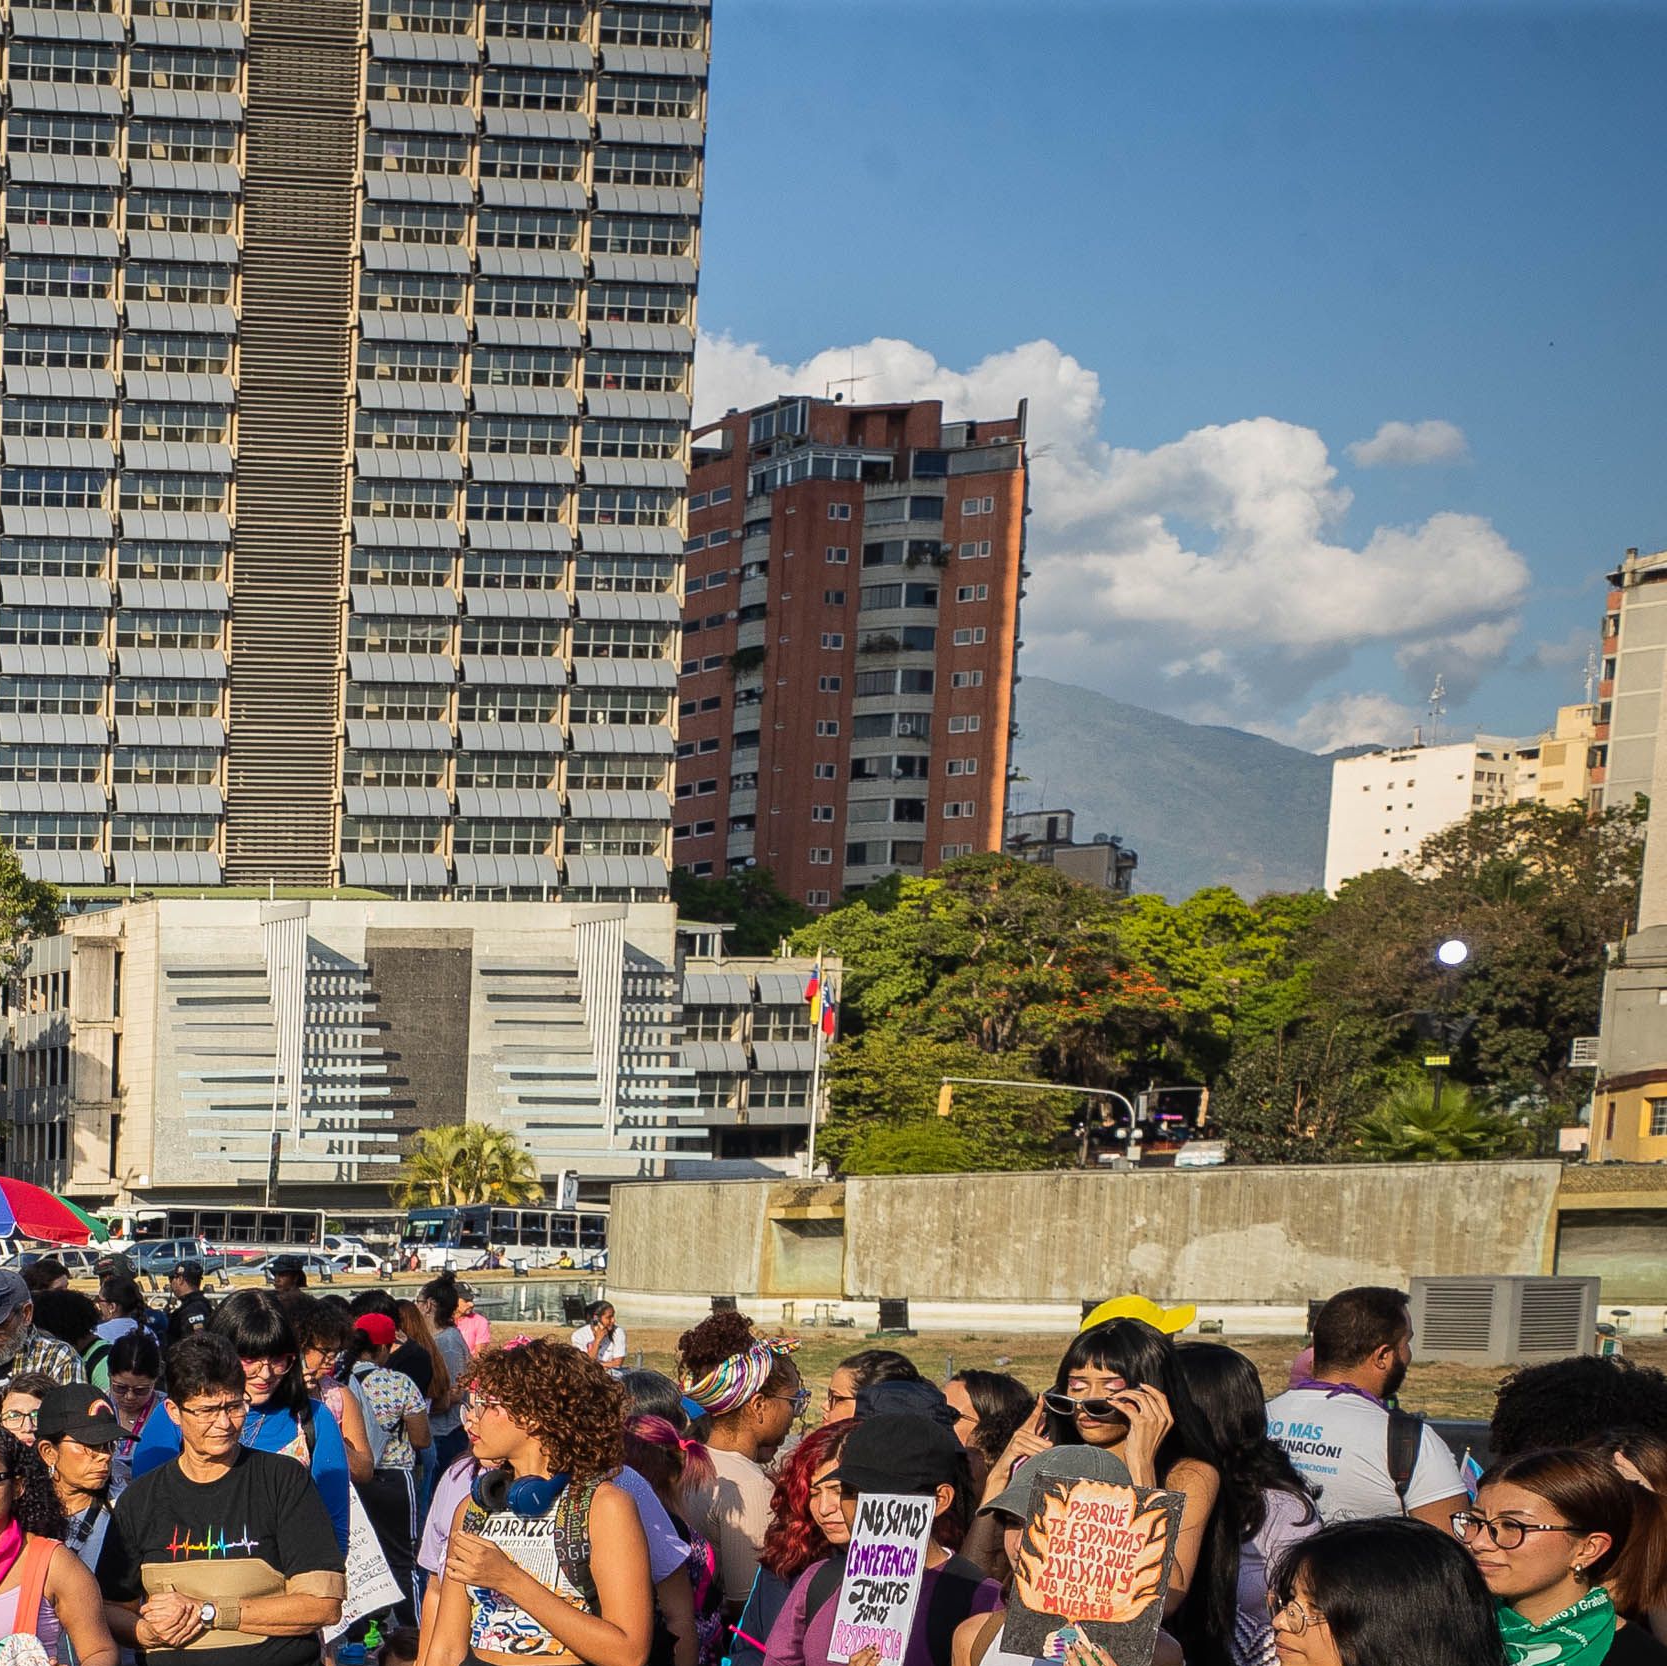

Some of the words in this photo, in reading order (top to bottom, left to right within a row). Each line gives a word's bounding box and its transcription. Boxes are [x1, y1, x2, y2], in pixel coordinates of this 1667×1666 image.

[883, 1500, 928, 1540] SOMOS
[1049, 1519, 1066, 1536] TE
[1070, 1522, 1146, 1553] ESPANTAS
[847, 1539, 918, 1577] COMPETENCIA
[1049, 1537, 1076, 1555] POR
[1079, 1545, 1104, 1562] LAS
[1105, 1550, 1137, 1570] QUE
[1035, 1577, 1058, 1594] NO
[1063, 1583, 1088, 1601] POR
[1043, 1557, 1116, 1590] LUCHAN
[848, 1579, 910, 1605] JUNTAS
[1043, 1595, 1113, 1619] MUEREN
[853, 1603, 890, 1624] SOMOS
